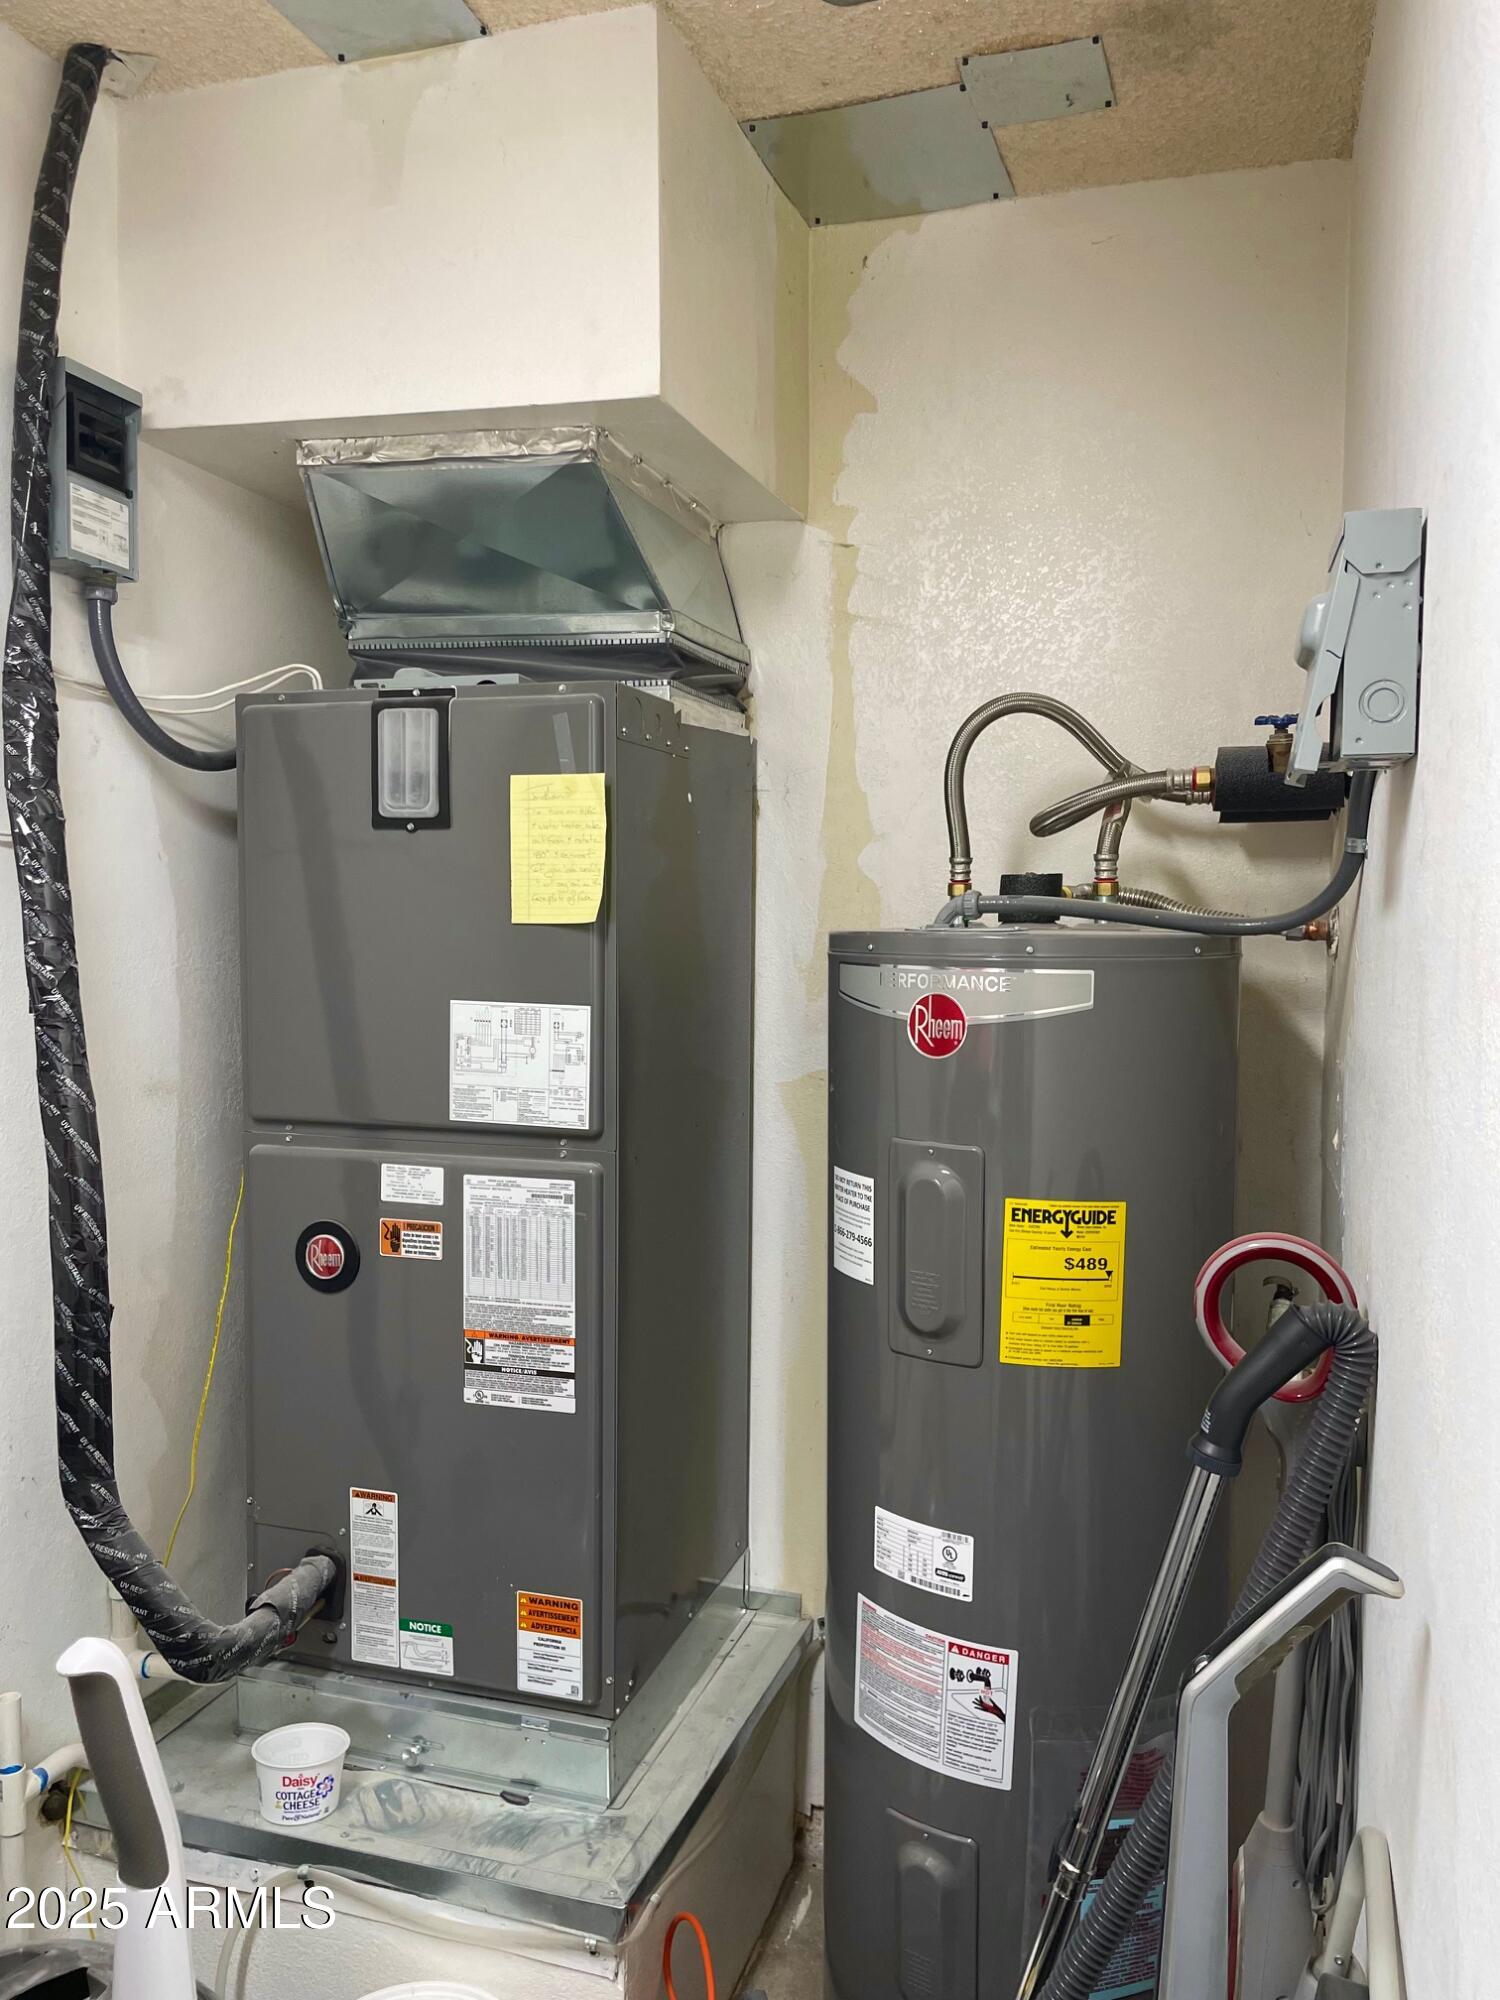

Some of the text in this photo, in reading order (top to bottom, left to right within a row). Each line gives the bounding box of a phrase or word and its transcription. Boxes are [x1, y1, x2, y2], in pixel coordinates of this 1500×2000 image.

[879, 972, 1011, 992] RFORMANCE
[914, 995, 964, 1048] Rheem
[1011, 1207, 1117, 1228] ENERGYGUIDE
[310, 1239, 341, 1272] Rheem
[1064, 1256, 1108, 1271] $489
[528, 1596, 578, 1611] WARNING
[409, 1621, 442, 1634] NOTICE
[961, 1647, 1006, 1664] DANGER
[282, 1773, 318, 1788] Daisy
[275, 1789, 316, 1801] COTTAGE
[283, 1798, 320, 1811] CHEESE
